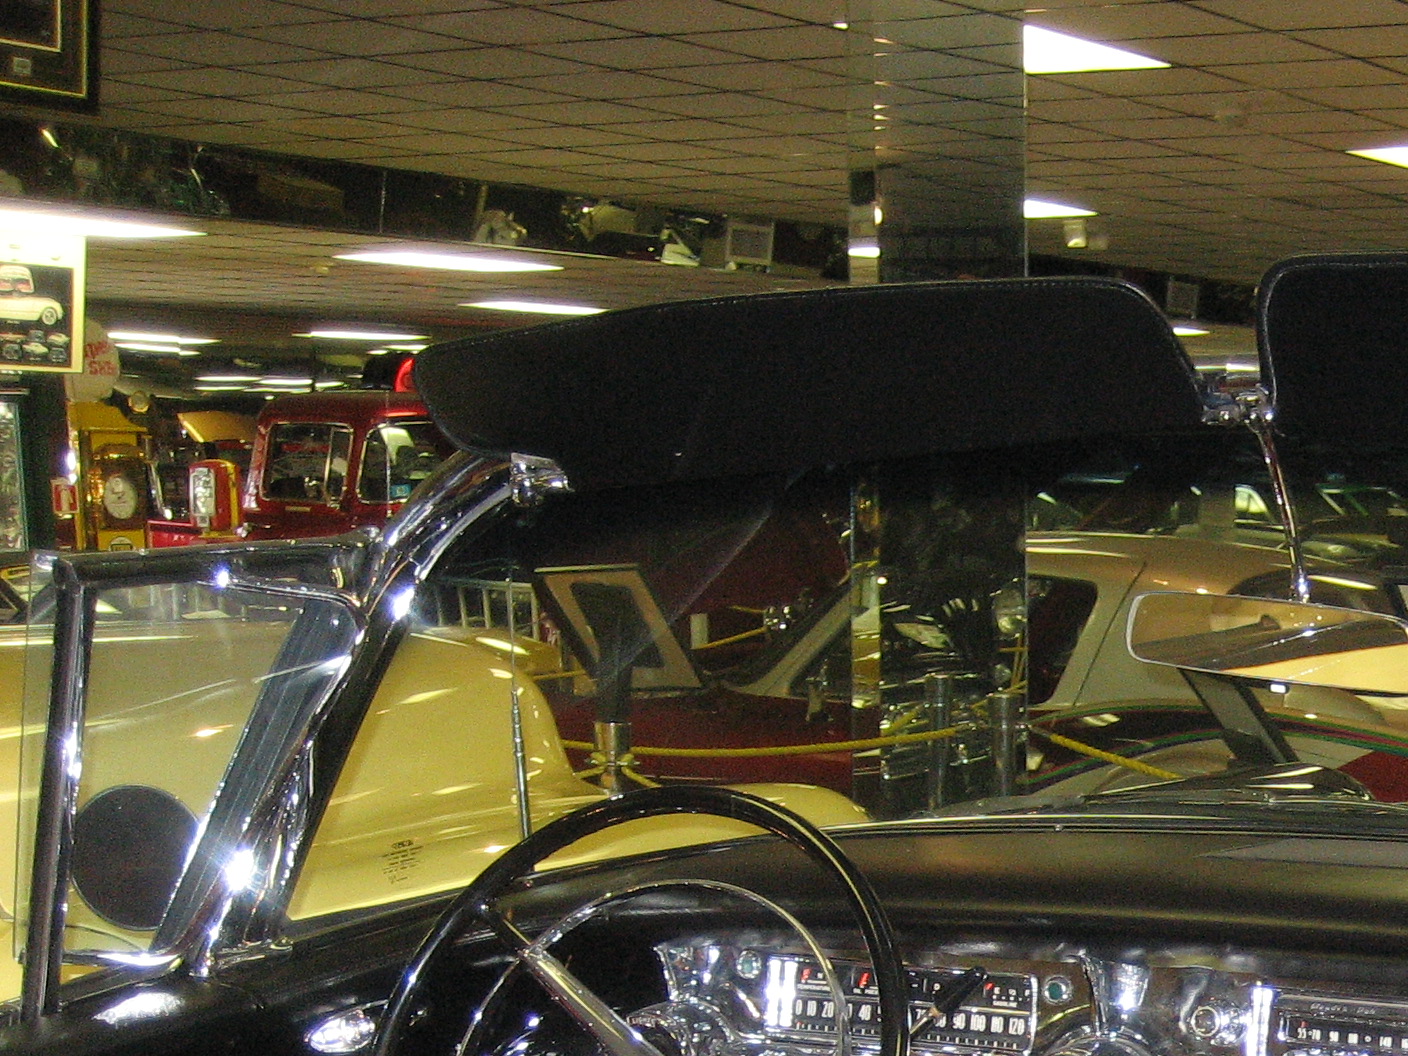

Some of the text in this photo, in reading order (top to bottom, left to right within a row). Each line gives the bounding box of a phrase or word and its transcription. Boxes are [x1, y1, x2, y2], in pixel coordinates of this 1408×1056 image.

[795, 999, 803, 1016] 0
[807, 1000, 817, 1017] 10
[822, 1001, 835, 1018] 20
[858, 1004, 872, 1021] 40
[953, 1013, 966, 1030] 90
[970, 1014, 987, 1033] 100
[991, 1016, 1005, 1034] 110
[1009, 1018, 1026, 1036] 120
[1312, 1029, 1321, 1041] 70
